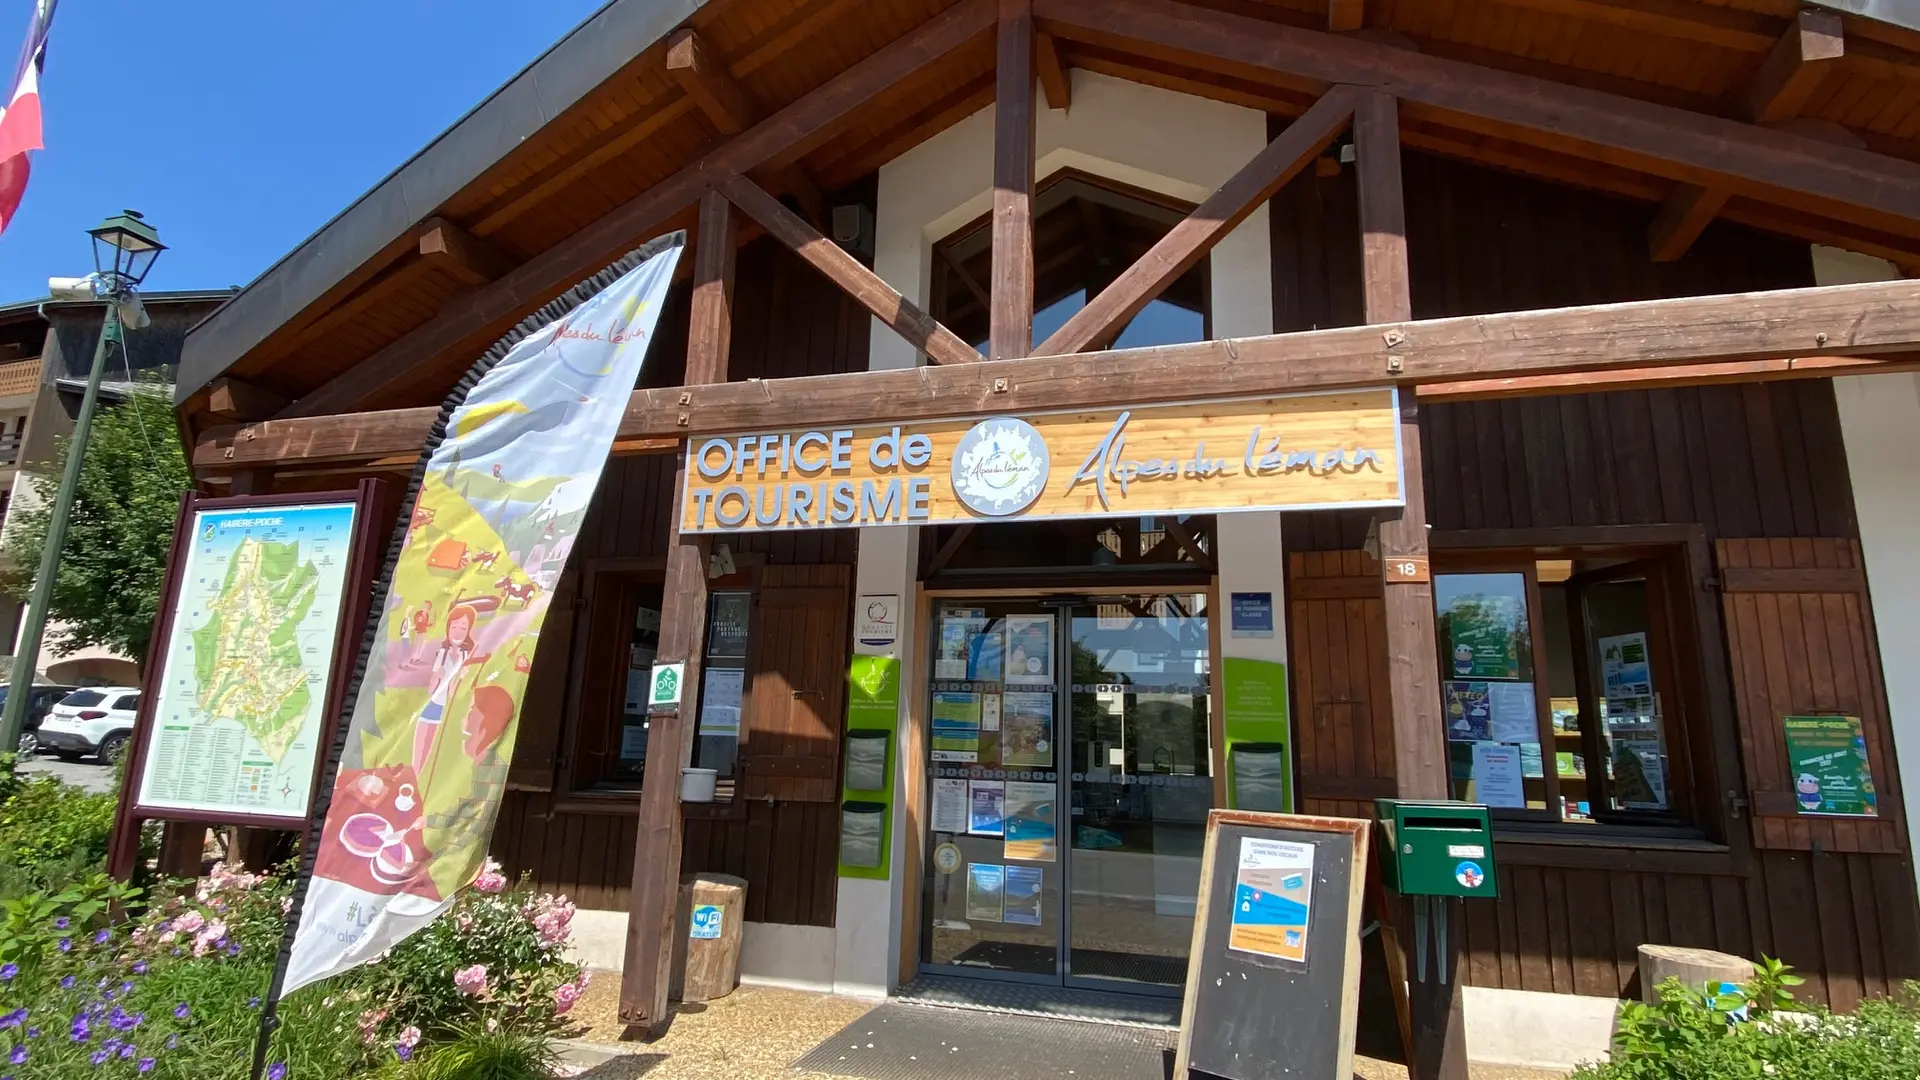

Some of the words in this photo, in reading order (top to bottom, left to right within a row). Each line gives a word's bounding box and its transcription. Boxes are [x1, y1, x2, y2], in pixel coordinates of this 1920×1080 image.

[697, 429, 853, 478] OFFICE
[869, 427, 932, 468] de
[1004, 460, 1030, 474] léman
[1063, 410, 1178, 511] Alpes
[1184, 441, 1234, 478] du
[1243, 425, 1382, 477] léman
[693, 476, 930, 528] TOURISME
[1396, 562, 1416, 577] 18
